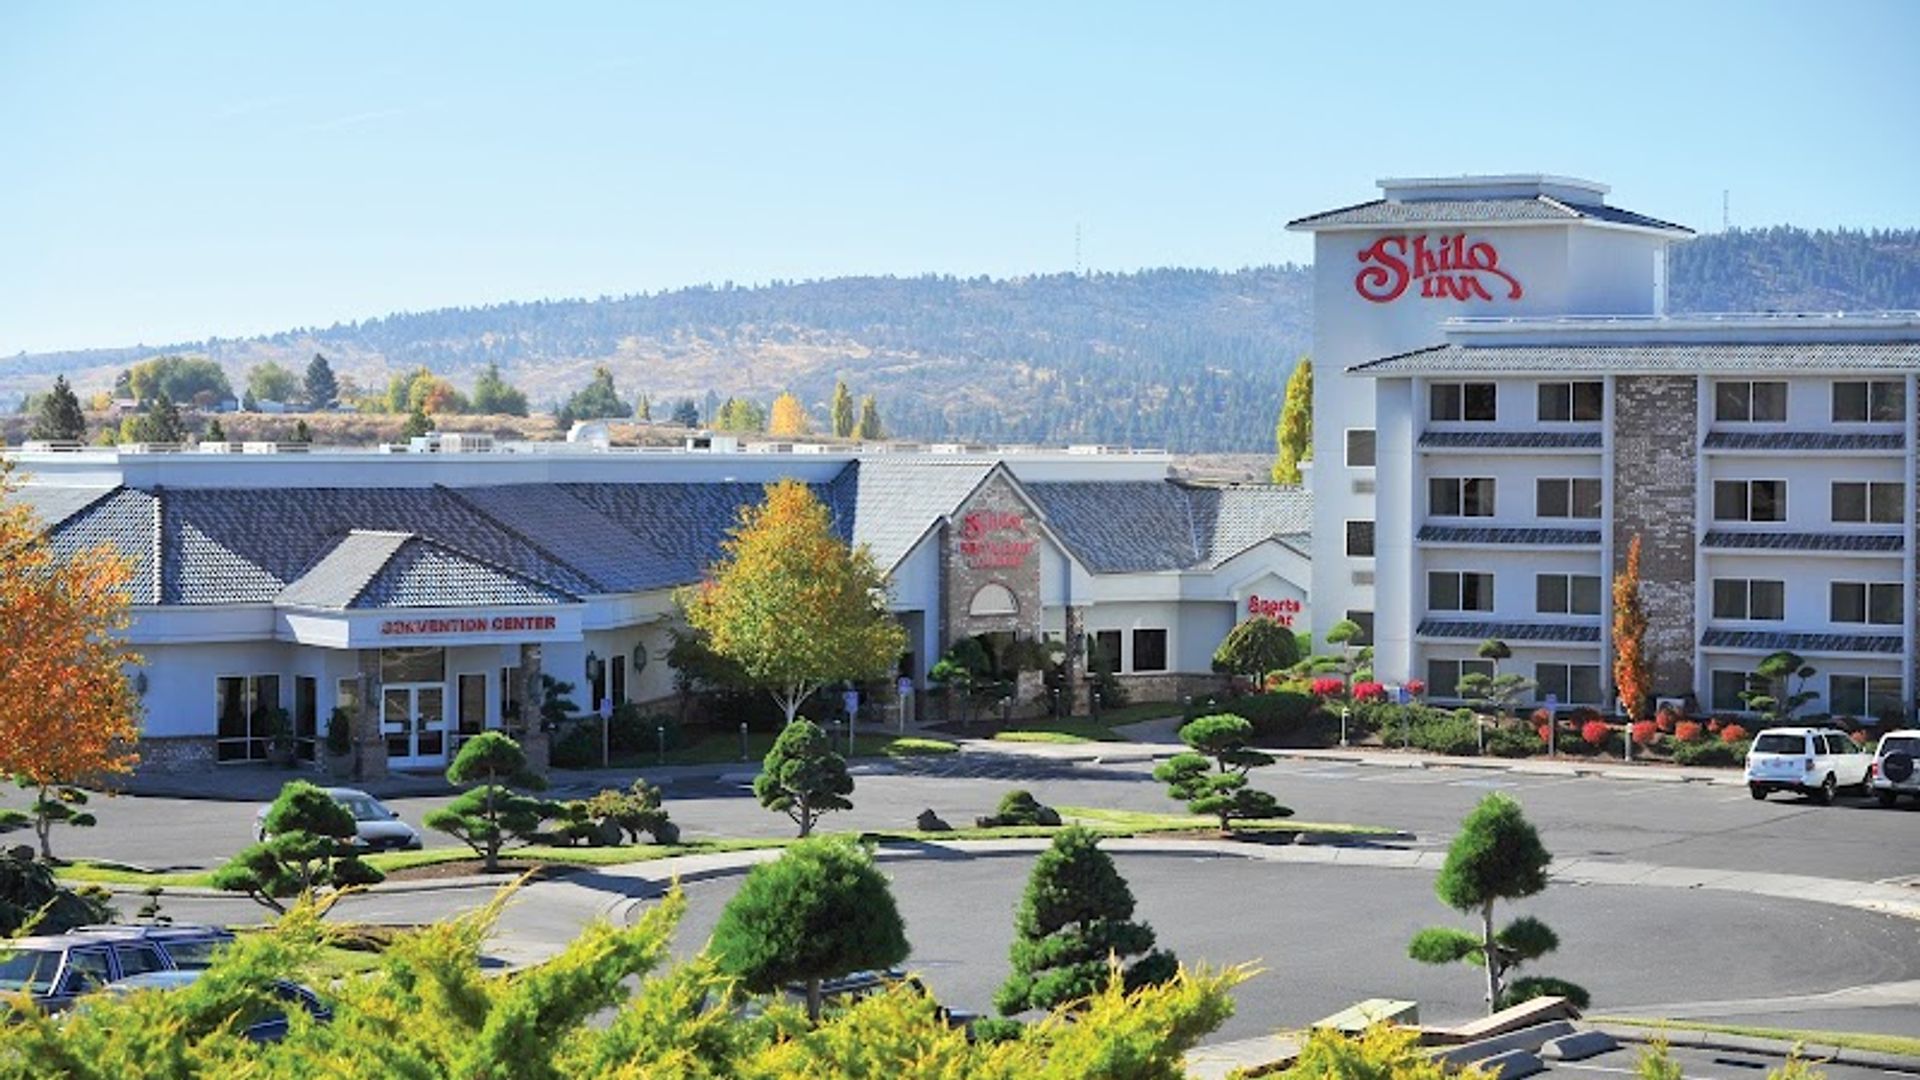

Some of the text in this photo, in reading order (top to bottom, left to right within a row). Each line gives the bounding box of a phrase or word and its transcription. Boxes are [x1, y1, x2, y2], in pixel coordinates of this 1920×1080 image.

[1356, 232, 1523, 303] Shilo
[1248, 595, 1301, 614] Sports
[382, 616, 556, 635] CONVENTION CENTER
